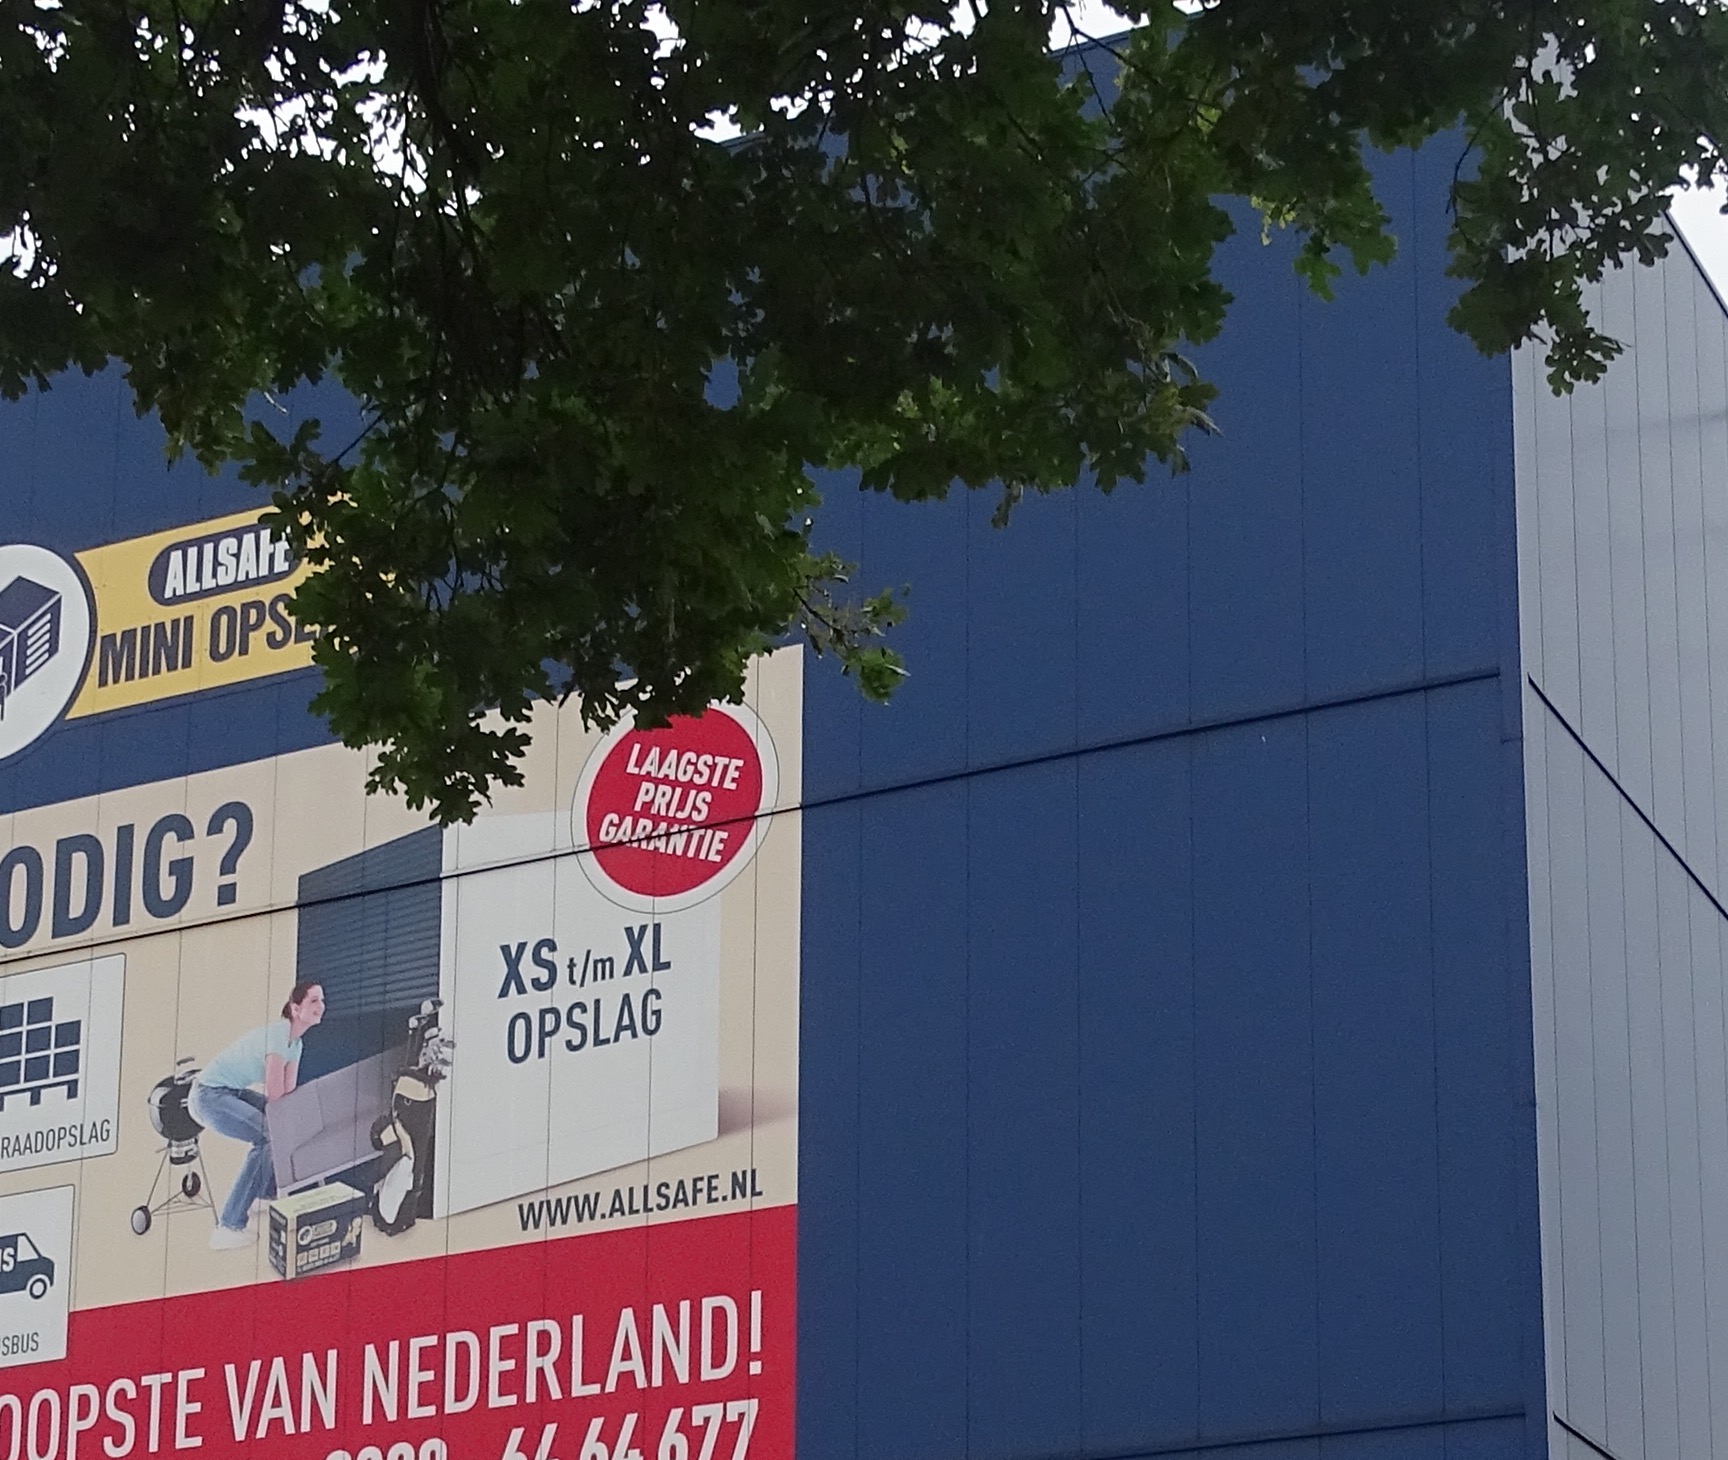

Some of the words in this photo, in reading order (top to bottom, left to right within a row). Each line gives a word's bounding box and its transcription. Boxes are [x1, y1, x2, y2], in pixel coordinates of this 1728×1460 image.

[98, 615, 194, 688] MINI
[626, 743, 744, 790] LAAGSTE
[634, 782, 712, 822] PRIJS
[599, 813, 729, 863] GARANTIE
[498, 939, 558, 999] XS
[567, 950, 614, 988] t/m
[623, 922, 671, 978] XL
[507, 988, 663, 1065] OPSLAG
[518, 1168, 763, 1232] WWW.ALLSAFE.NL
[224, 1348, 338, 1442] VAN
[363, 1289, 763, 1426] NEDERLAND!
